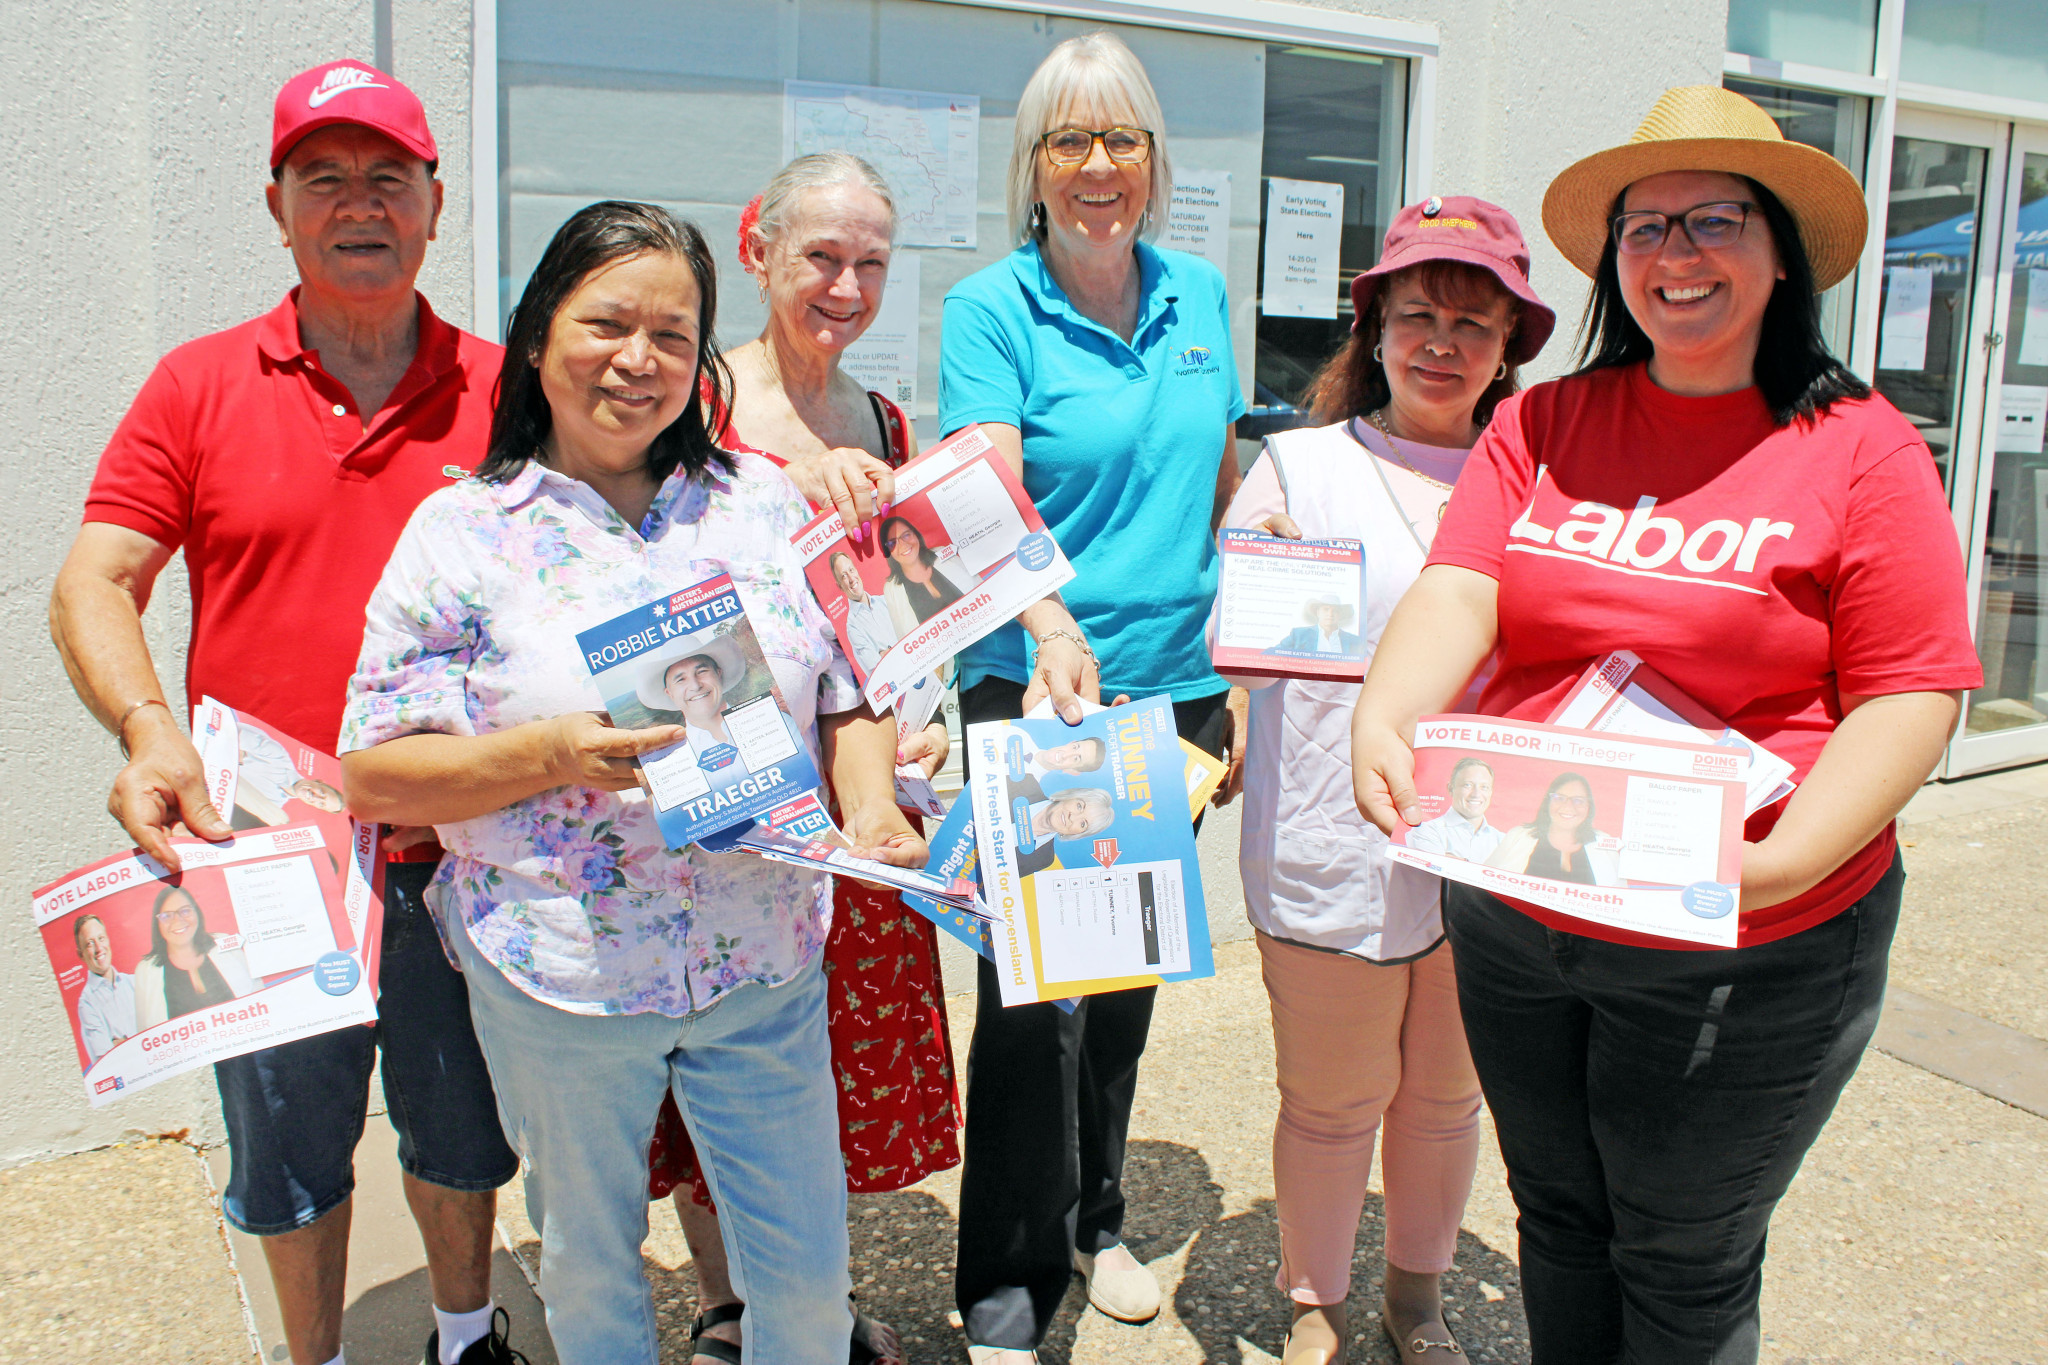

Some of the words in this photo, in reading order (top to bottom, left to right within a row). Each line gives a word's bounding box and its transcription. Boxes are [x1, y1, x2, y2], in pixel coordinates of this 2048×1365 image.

[321, 67, 375, 90] NIKE
[1185, 197, 1219, 207] Elections
[1201, 187, 1215, 195] Day
[1285, 195, 1303, 205] Early
[1305, 197, 1326, 207] Voting
[1171, 212, 1205, 221] SATURDAY
[1280, 207, 1298, 215] State
[1300, 208, 1332, 219] Elections
[1419, 219, 1440, 228] GOOD
[1442, 218, 1477, 230] SHEPHERD
[1177, 224, 1209, 232] OCTOBER
[1191, 235, 1205, 243] 6pm
[1296, 232, 1314, 240] Here
[1306, 255, 1317, 263] Oct
[878, 364, 899, 372] before
[949, 432, 980, 455] DOING
[941, 477, 960, 492] BALLOT
[959, 467, 976, 481] PAPER
[1509, 464, 1795, 573] Labor
[799, 532, 823, 557] VOTE
[821, 517, 844, 539] LAB
[1227, 531, 1257, 541] KAP
[1327, 539, 1360, 550] LAW
[1287, 550, 1319, 558] HOME?
[1291, 568, 1331, 577] SOLUTIONS
[670, 589, 715, 612] AUSTRALIAN
[671, 586, 702, 604] KATTER'S
[587, 626, 661, 669] ROBBIE
[659, 593, 738, 639] KATTER
[901, 615, 951, 657] Georgia
[948, 589, 992, 623] Heath
[909, 641, 937, 665] LABOR
[935, 629, 954, 647] FOR
[954, 602, 997, 634] TRAEGER
[1592, 655, 1622, 689] DOING
[1104, 718, 1115, 732] LNP
[1154, 708, 1164, 726] VOTE
[1139, 709, 1157, 750] Yvonne
[982, 737, 995, 763] LNP
[1107, 732, 1118, 750] FOR
[1423, 727, 1472, 740] VOTE
[1475, 729, 1542, 749] LABOR
[1545, 739, 1562, 752] in
[1567, 742, 1636, 764] Traeger
[716, 756, 733, 768] KAP
[1115, 711, 1154, 824] TUNNEY
[1693, 754, 1738, 767] DOING
[985, 772, 997, 783] A
[1109, 750, 1126, 800] TRAEGER
[681, 764, 786, 824] TRAEGER
[1648, 782, 1676, 791] BALLOT
[1678, 786, 1702, 794] PAPER
[684, 815, 715, 833] Authorised
[713, 811, 723, 821] by:
[725, 803, 743, 816] Major
[740, 799, 751, 808] for
[750, 790, 772, 804] Katter's
[771, 779, 798, 794] Australian
[686, 829, 703, 841] Party,
[701, 822, 718, 834] 2/321
[717, 816, 732, 827] Sturt
[730, 808, 750, 821] Street,
[748, 796, 777, 813] Townsville
[775, 791, 789, 801] QLD
[787, 785, 802, 796] 4810
[771, 805, 795, 818] KATTER'S
[987, 785, 1002, 826] Fresh
[772, 809, 805, 825] AUSTRALIAN
[270, 828, 312, 842] DOING
[358, 823, 371, 855] BOR
[939, 837, 971, 877] Right
[991, 829, 1008, 868] Start
[1642, 842, 1665, 850] HEATH,
[1666, 845, 1691, 854] Georgia
[242, 865, 269, 875] BALLOT
[270, 861, 293, 870] PAPER
[357, 856, 366, 867] in
[40, 889, 75, 915] VOTE
[76, 866, 132, 898] LABOR
[997, 870, 1012, 893] for
[1169, 879, 1177, 902] Election
[1481, 867, 1558, 896] Georgia
[1564, 886, 1624, 907] Heath
[349, 873, 365, 924] Traeger
[1106, 888, 1115, 914] TUNNEY,
[1559, 897, 1621, 915] TRAEGER
[1143, 905, 1152, 932] Traeger
[1156, 901, 1164, 924] Electoral
[260, 927, 283, 936] HEATH,
[282, 922, 306, 932] Georgia
[1109, 914, 1117, 936] Yvonne
[1172, 913, 1180, 936] Member
[219, 940, 239, 951] LABOR
[222, 934, 237, 944] VOTE
[1167, 931, 1175, 963] Queensland
[139, 1016, 207, 1053] Georgia
[209, 999, 270, 1028] Heath
[145, 1044, 182, 1065] LABOR
[182, 1034, 209, 1050] FOR
[211, 1017, 271, 1042] TRAEGER
[95, 1077, 116, 1092] Labor
